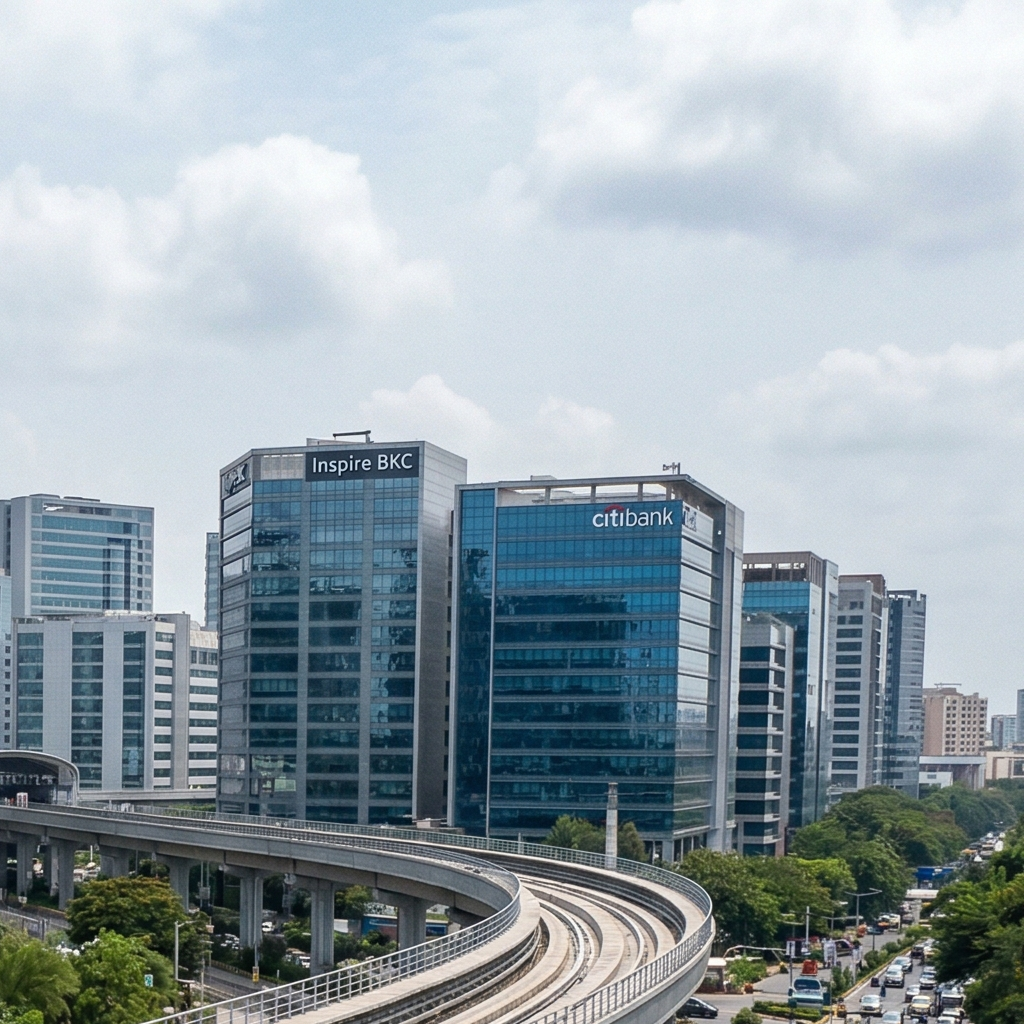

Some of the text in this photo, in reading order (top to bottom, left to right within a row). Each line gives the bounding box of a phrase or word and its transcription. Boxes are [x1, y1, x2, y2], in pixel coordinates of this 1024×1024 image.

[312, 453, 413, 477] Inspire BKC
[592, 506, 674, 528] citibank
